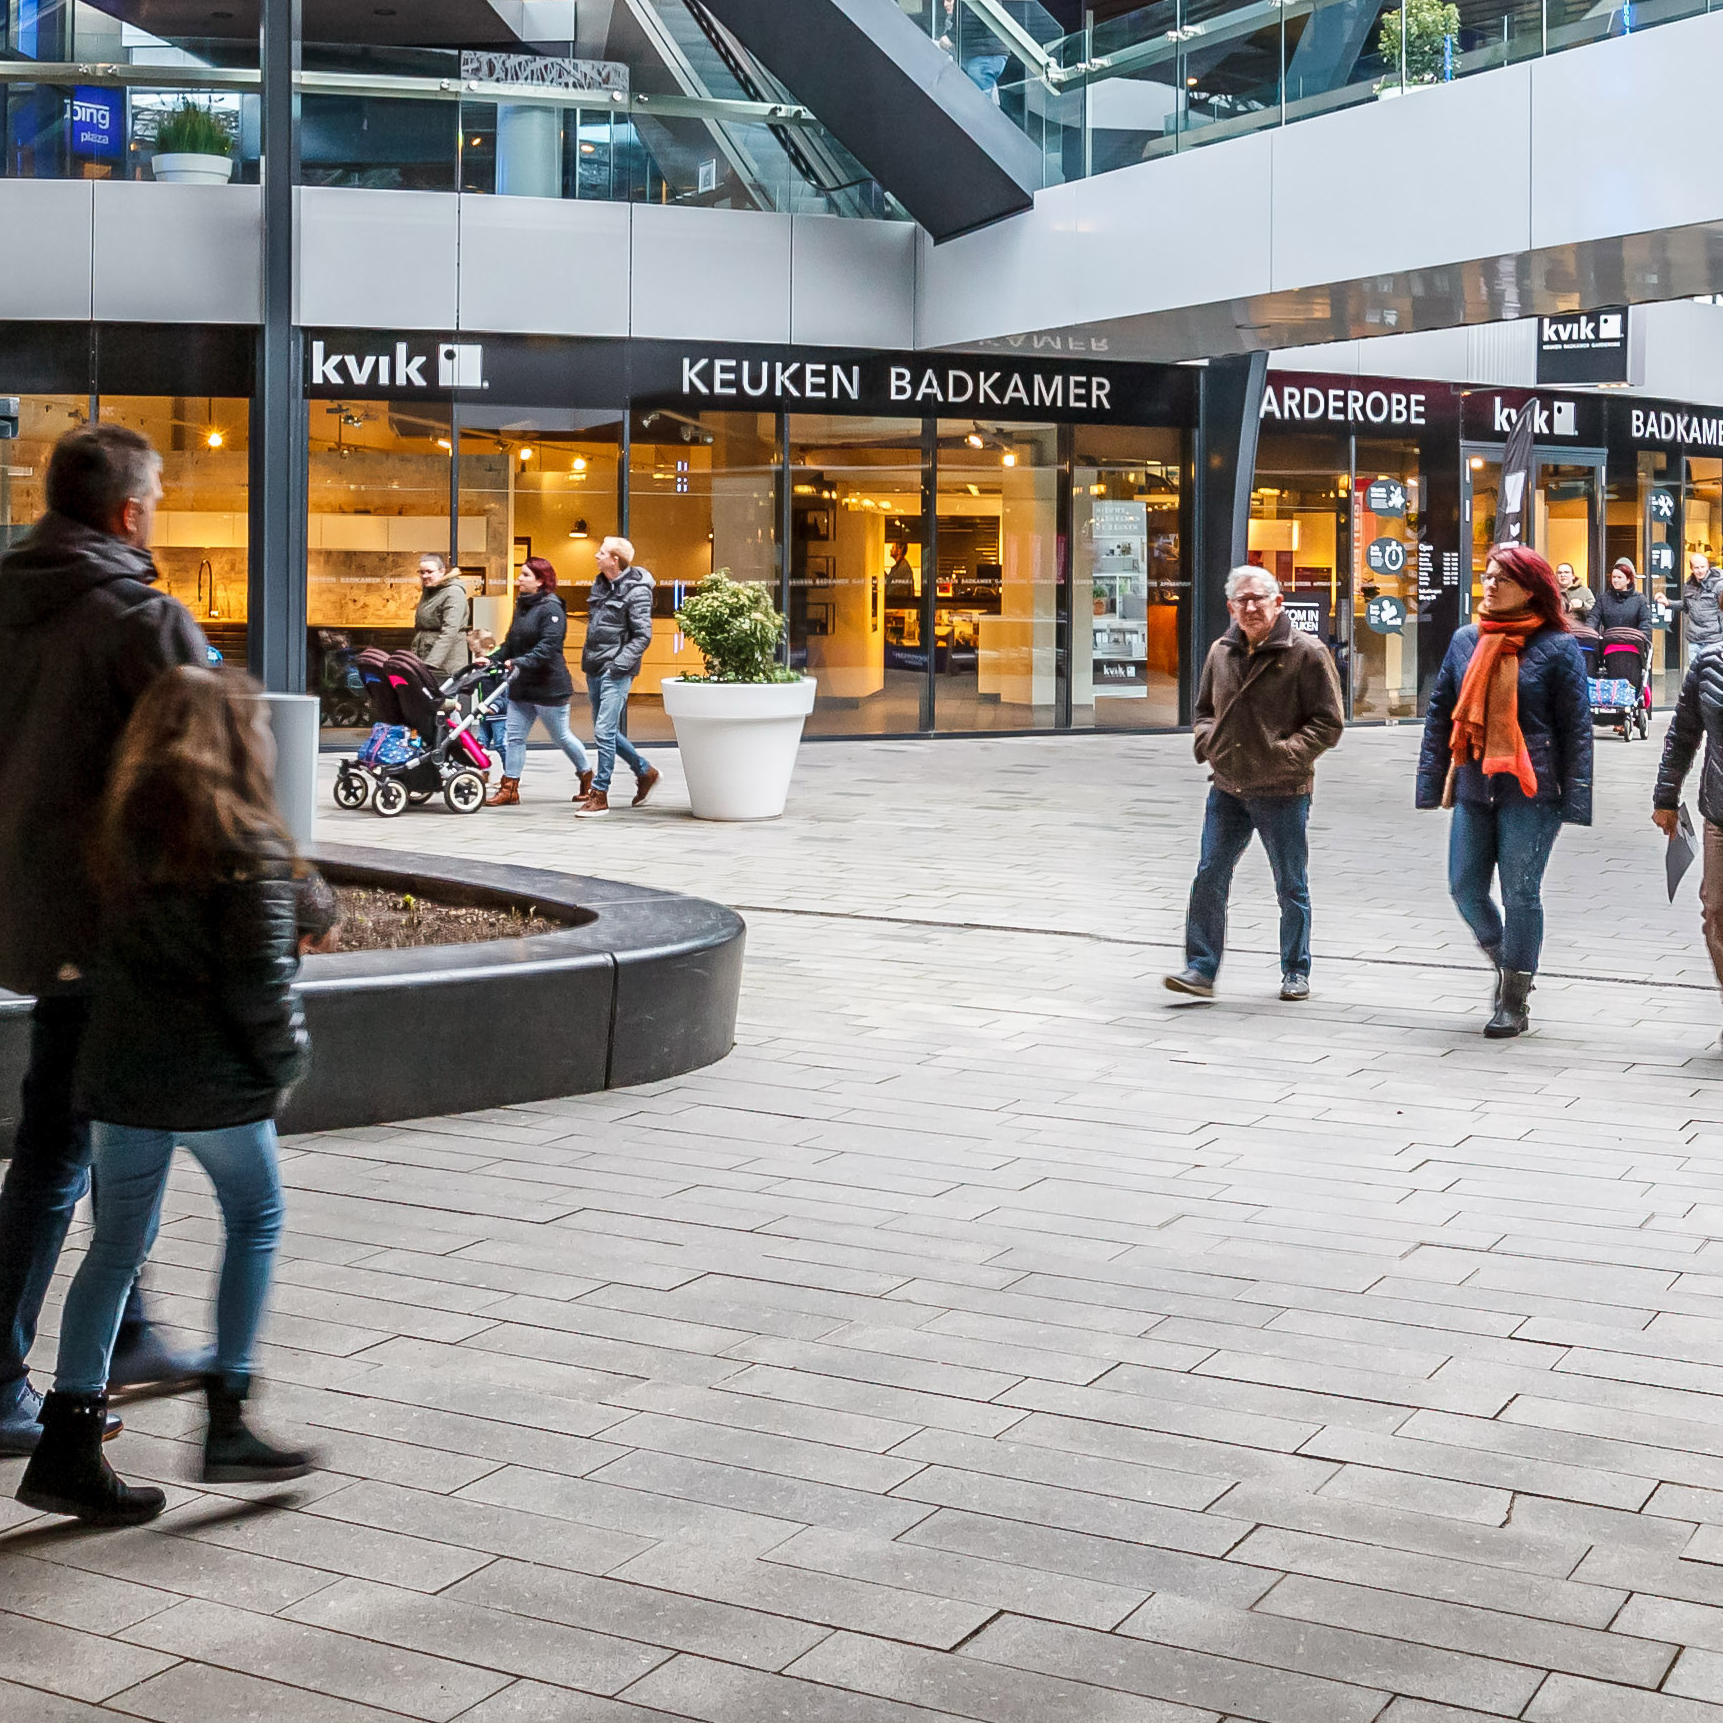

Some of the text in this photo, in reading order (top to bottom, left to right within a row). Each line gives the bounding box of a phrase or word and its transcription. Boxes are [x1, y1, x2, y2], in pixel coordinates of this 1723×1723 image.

[1543, 316, 1595, 341] kvik
[312, 341, 427, 387] kvik
[682, 357, 1111, 409] KEUKEN BADKAMER
[1260, 385, 1426, 425] ARDEROBE
[1291, 621, 1319, 632] EUKEN
[1308, 609, 1319, 622] IN
